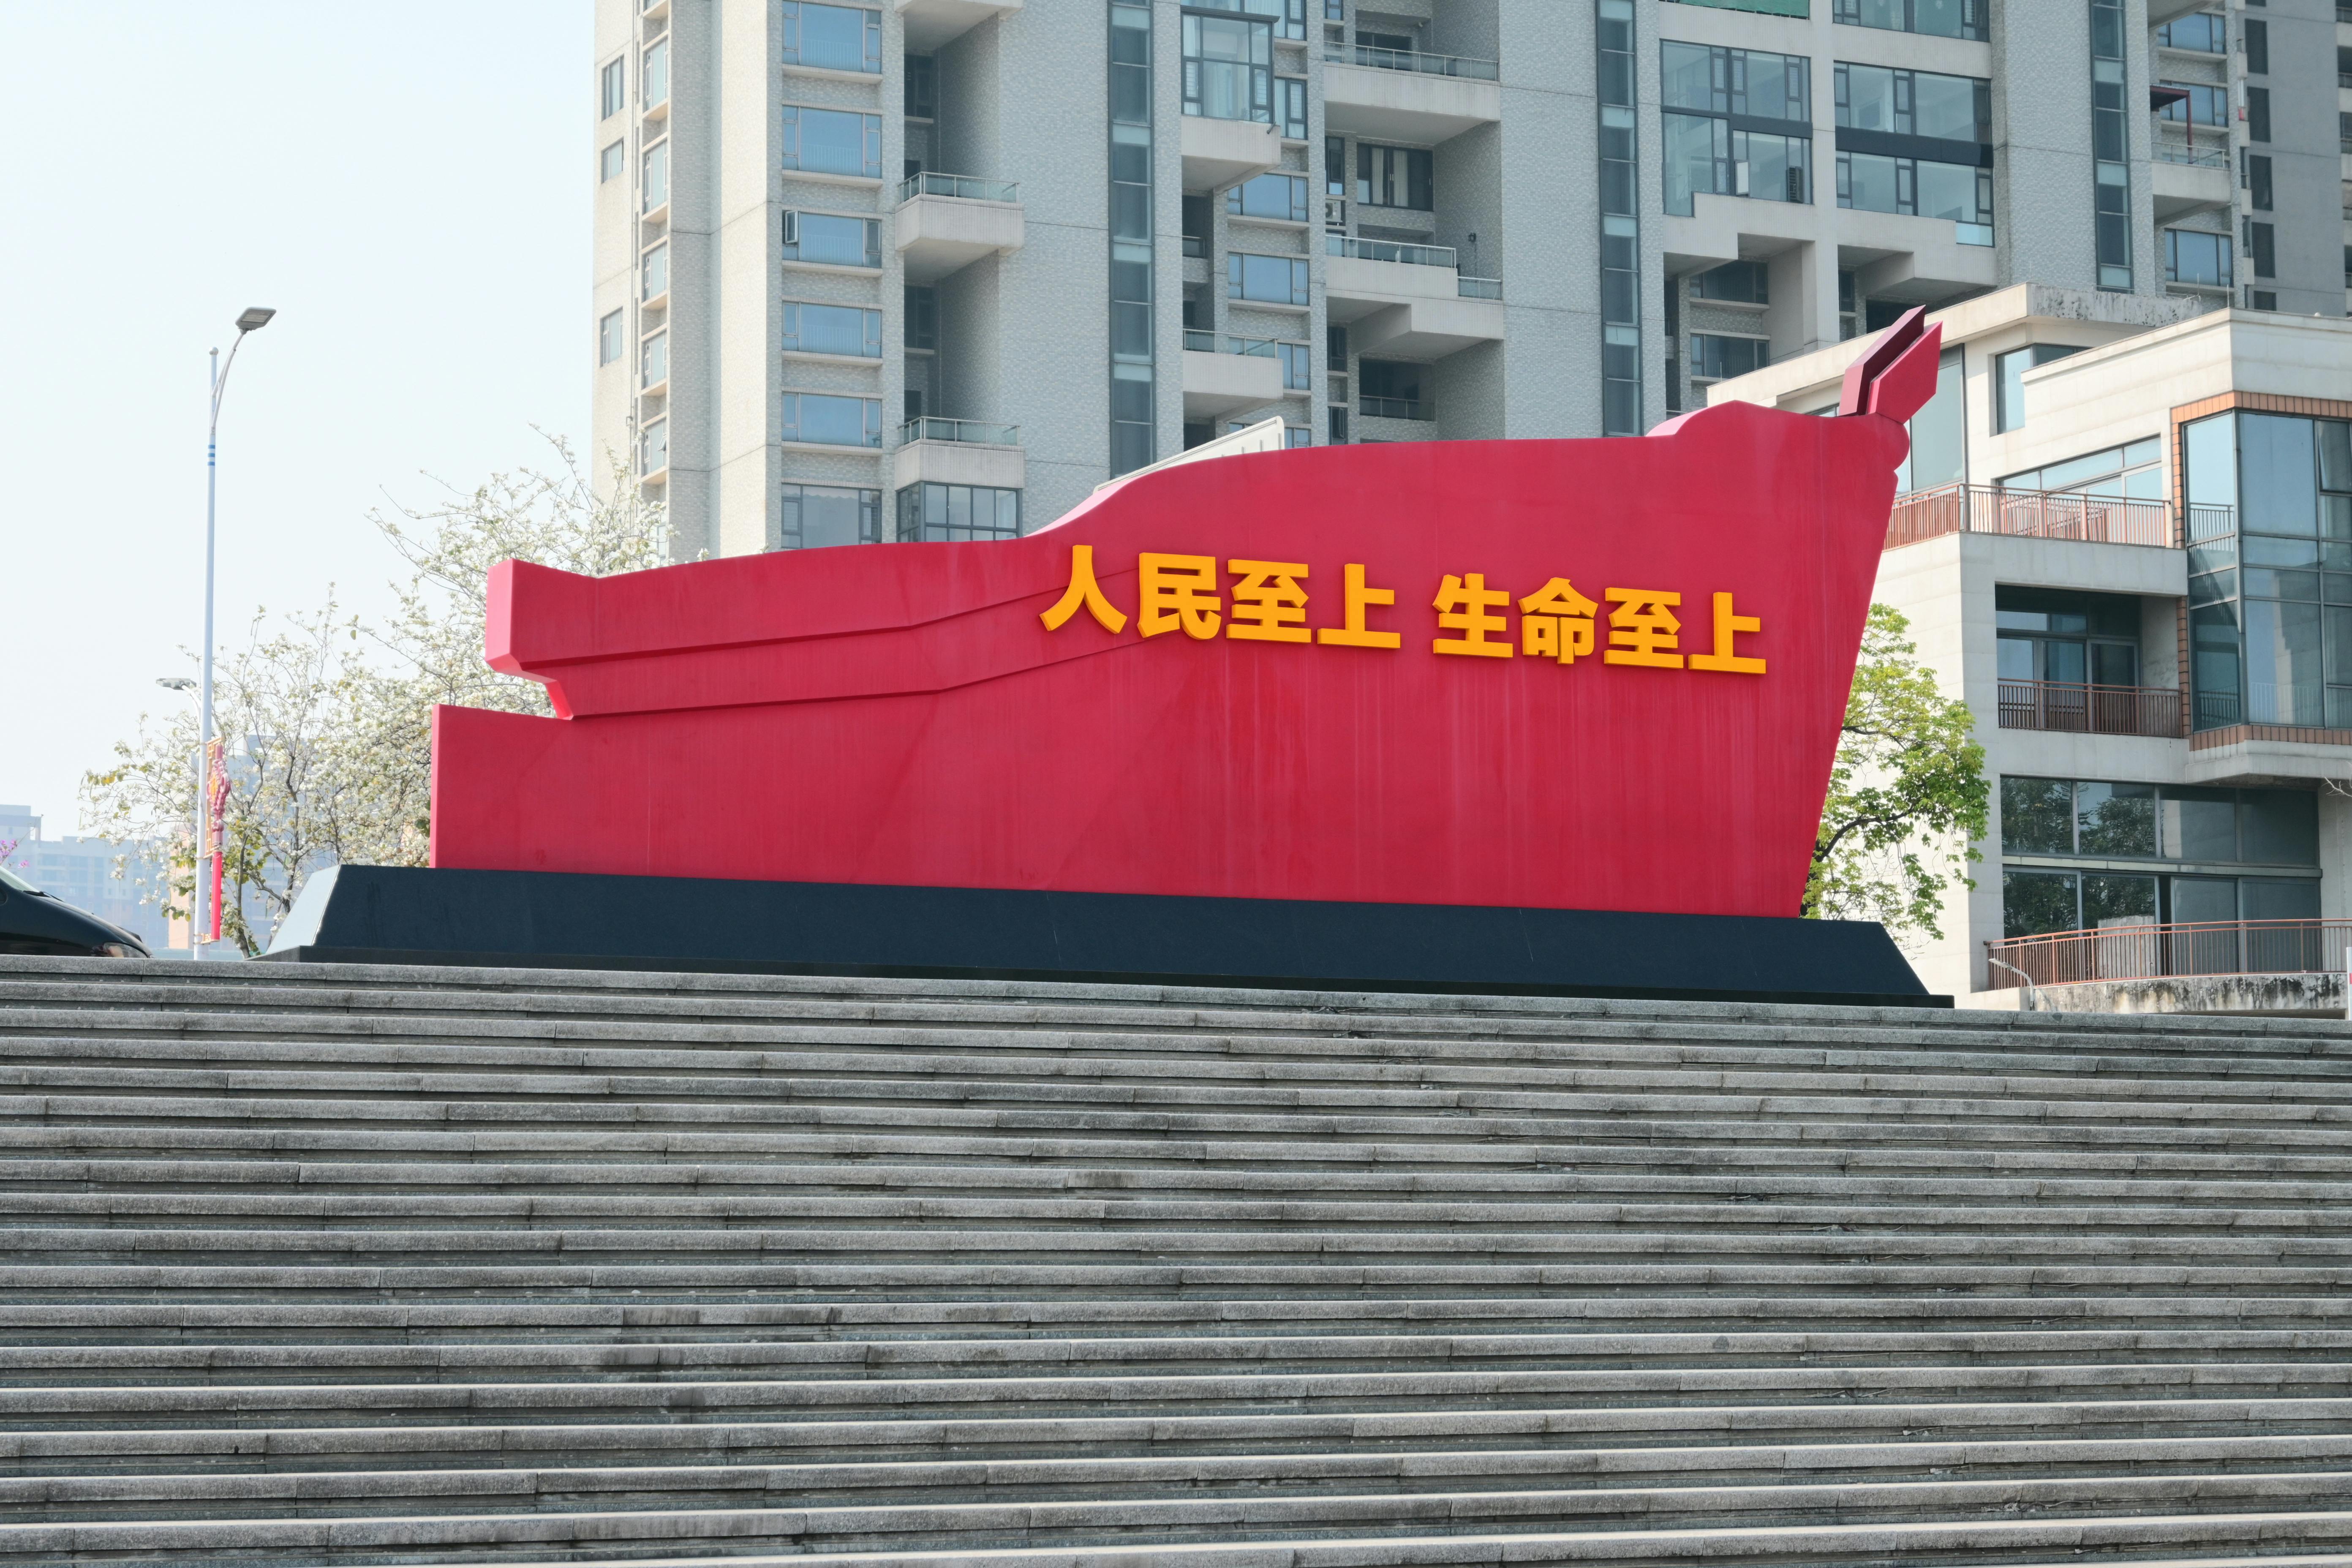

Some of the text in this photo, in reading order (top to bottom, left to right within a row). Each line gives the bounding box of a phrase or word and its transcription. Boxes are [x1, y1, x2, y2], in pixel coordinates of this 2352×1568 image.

[1039, 545, 1767, 674] 人民至上 生命至上
